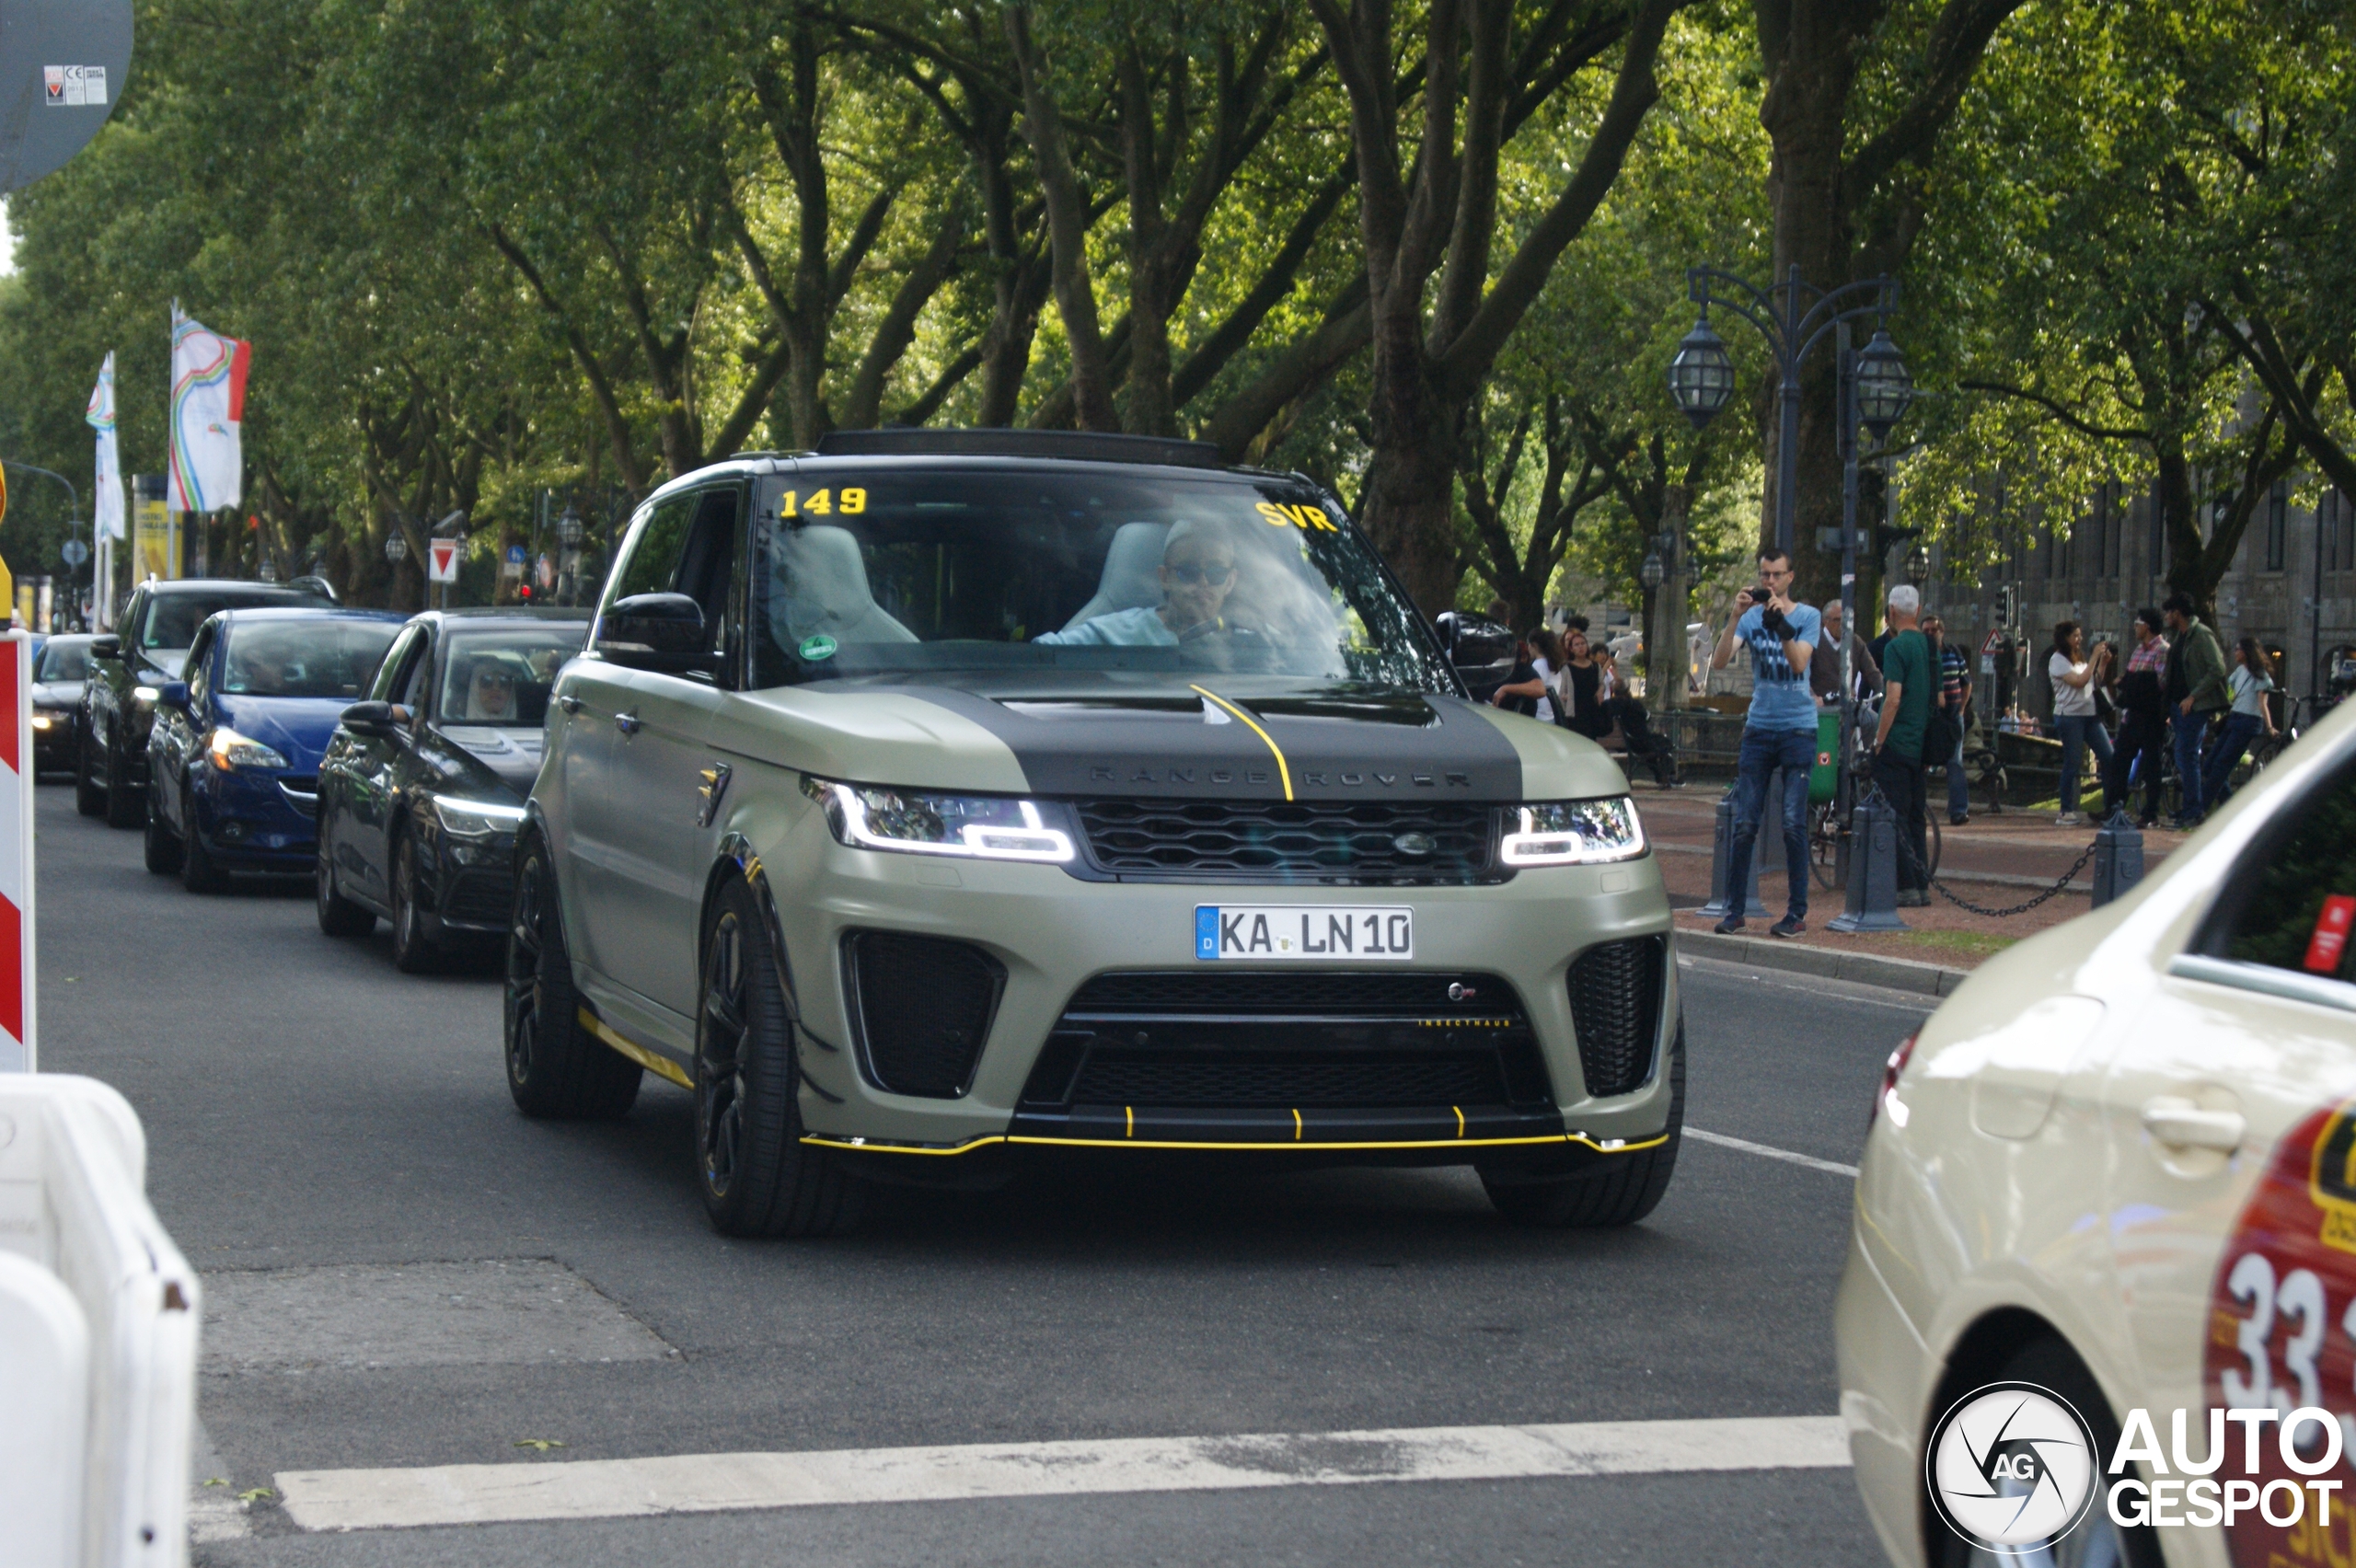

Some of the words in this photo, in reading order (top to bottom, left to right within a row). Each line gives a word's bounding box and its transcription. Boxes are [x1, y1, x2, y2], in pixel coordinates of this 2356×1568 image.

[780, 487, 867, 517] 149
[1254, 502, 1339, 533] SVR
[1090, 767, 1269, 785] RANGE
[1303, 771, 1471, 787] ROVER
[1220, 913, 1272, 953] KA
[1418, 1019, 1510, 1028] INSECTHAUS
